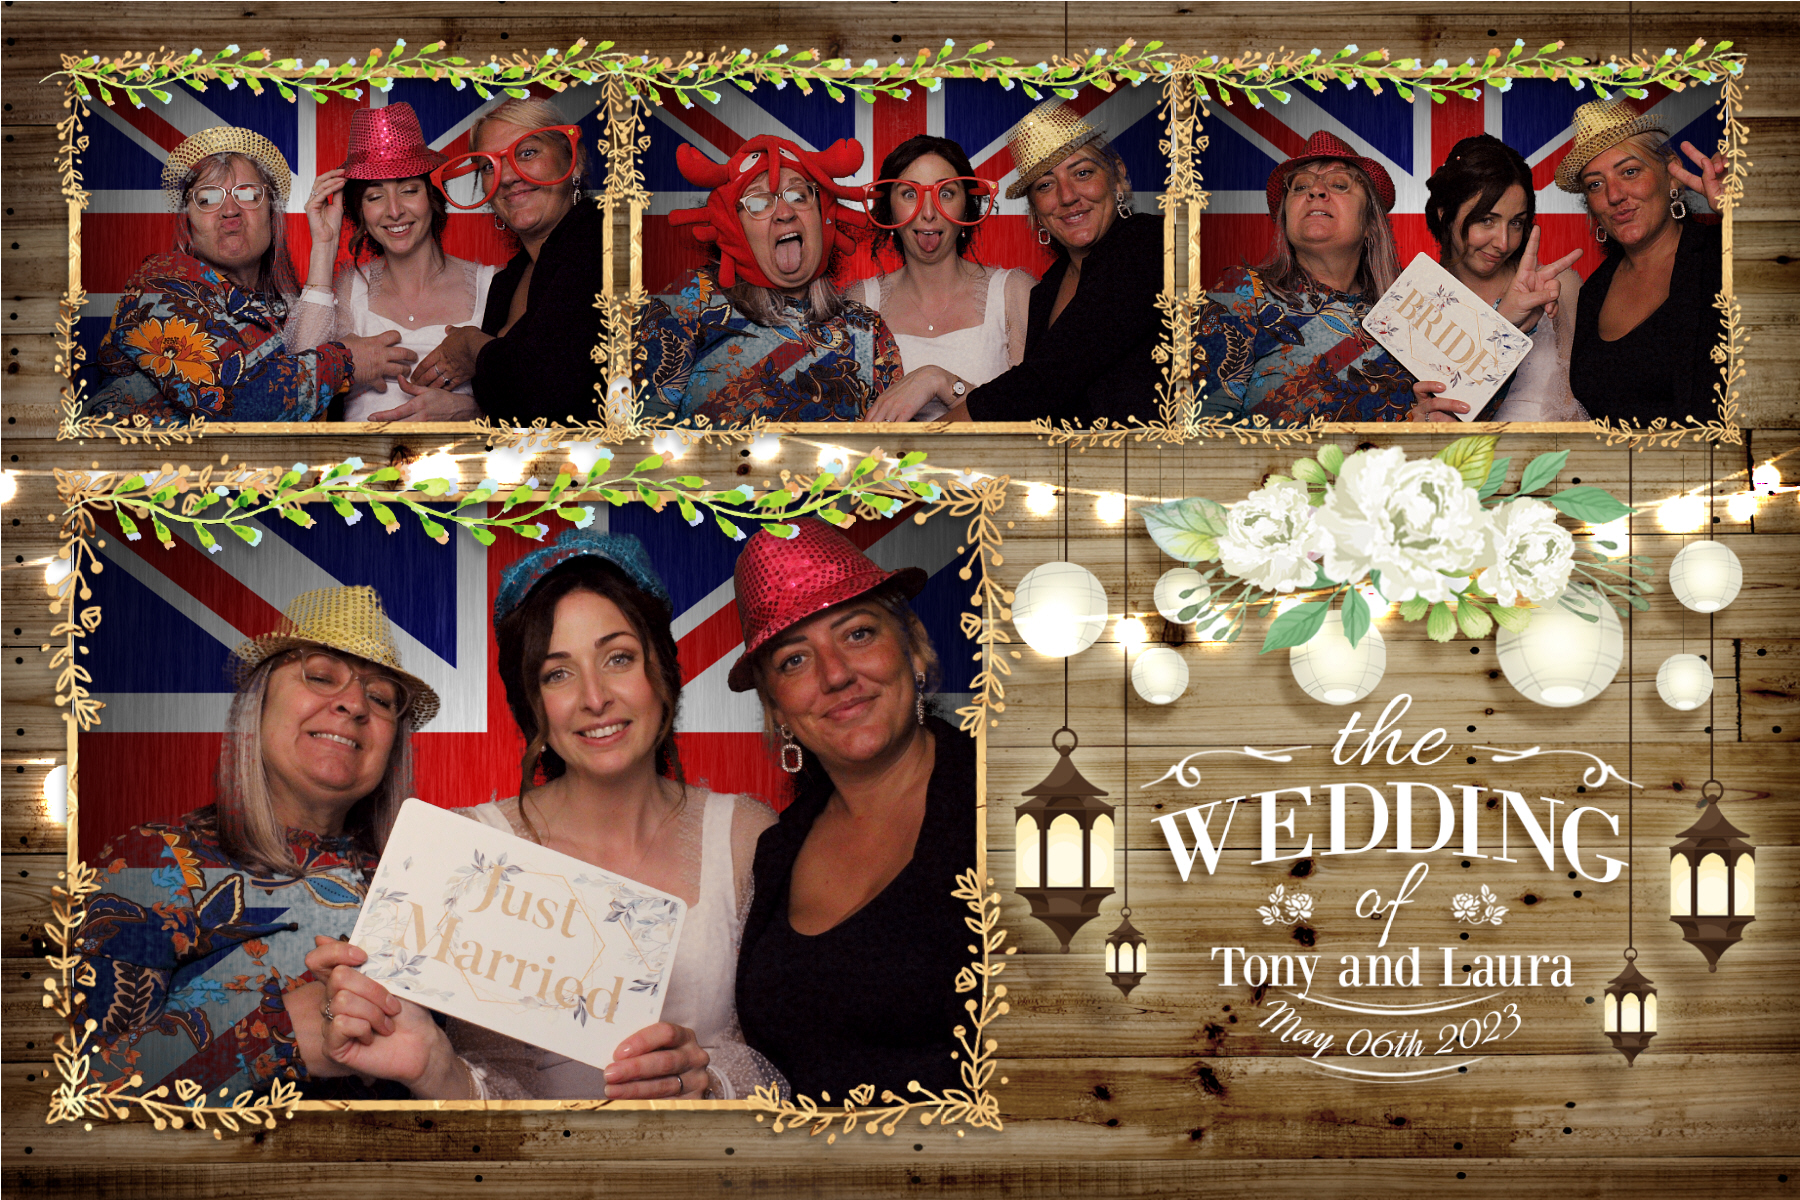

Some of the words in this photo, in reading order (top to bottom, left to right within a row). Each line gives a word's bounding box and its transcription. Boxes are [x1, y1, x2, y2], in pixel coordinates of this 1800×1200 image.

[1396, 288, 1498, 386] BRIDE
[468, 863, 582, 939] Just
[392, 900, 625, 1025] Married
